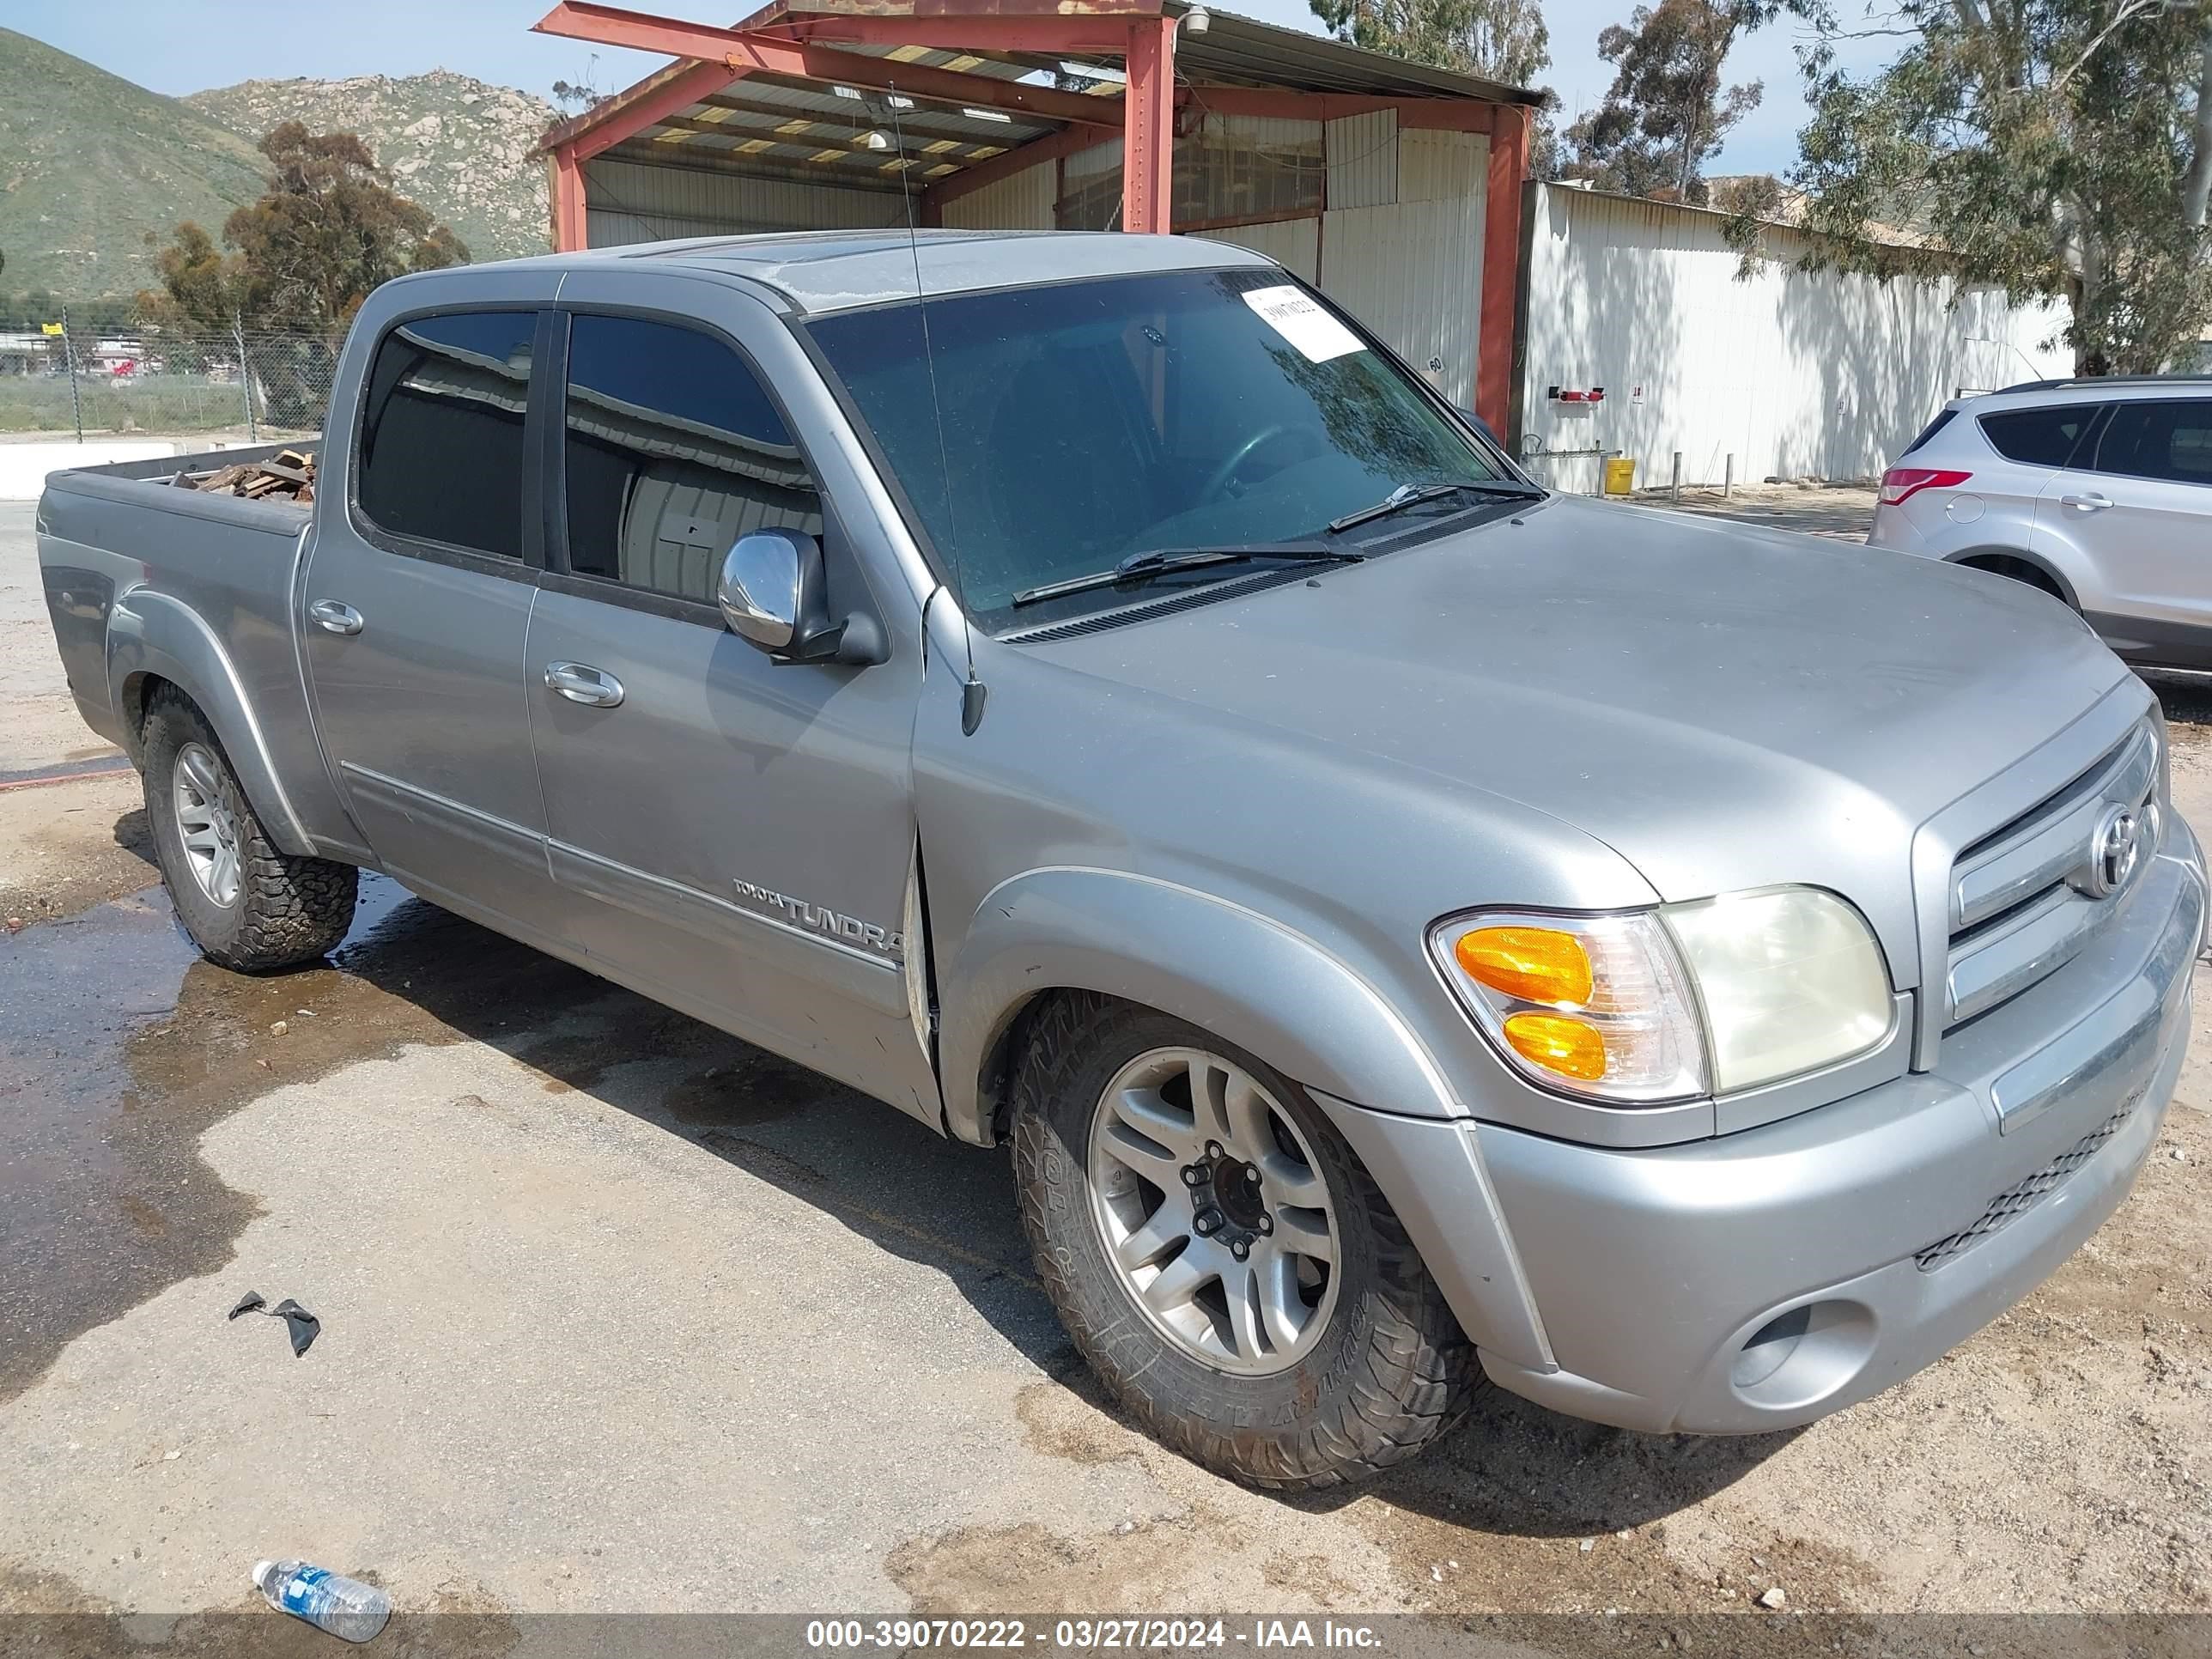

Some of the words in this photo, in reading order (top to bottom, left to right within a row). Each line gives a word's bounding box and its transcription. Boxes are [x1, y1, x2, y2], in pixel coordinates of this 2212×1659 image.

[1429, 357, 1442, 373] 60
[733, 878, 784, 908] TOYOTA
[779, 894, 904, 956] TUNDRA
